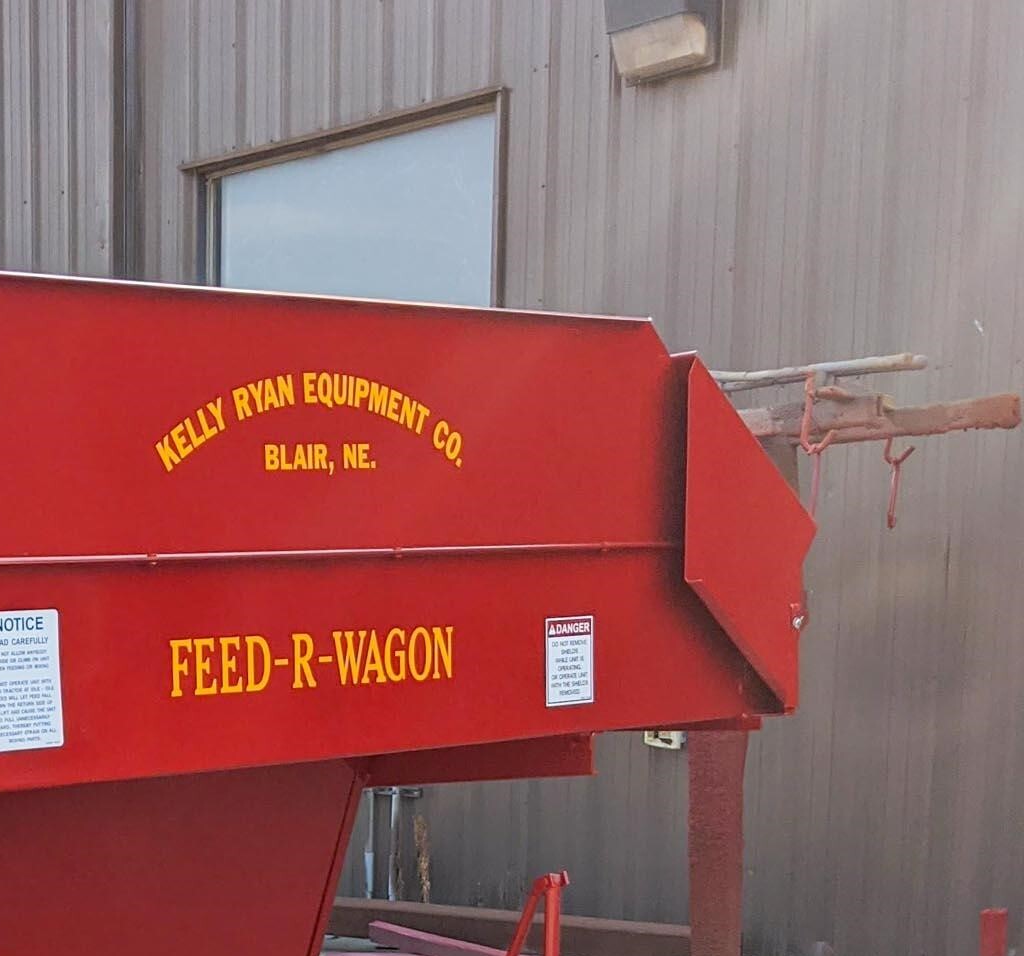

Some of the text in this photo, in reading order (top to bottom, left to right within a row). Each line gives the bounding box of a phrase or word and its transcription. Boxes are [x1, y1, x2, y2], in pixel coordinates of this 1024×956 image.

[155, 372, 463, 472] KELLY RYAN EQUIPMENT CO.
[264, 443, 376, 475] BLAIR, NE.
[11, 636, 49, 645] CAREFULLY
[556, 622, 590, 635] DANGER
[170, 626, 454, 698] FEED-R-WAGON
